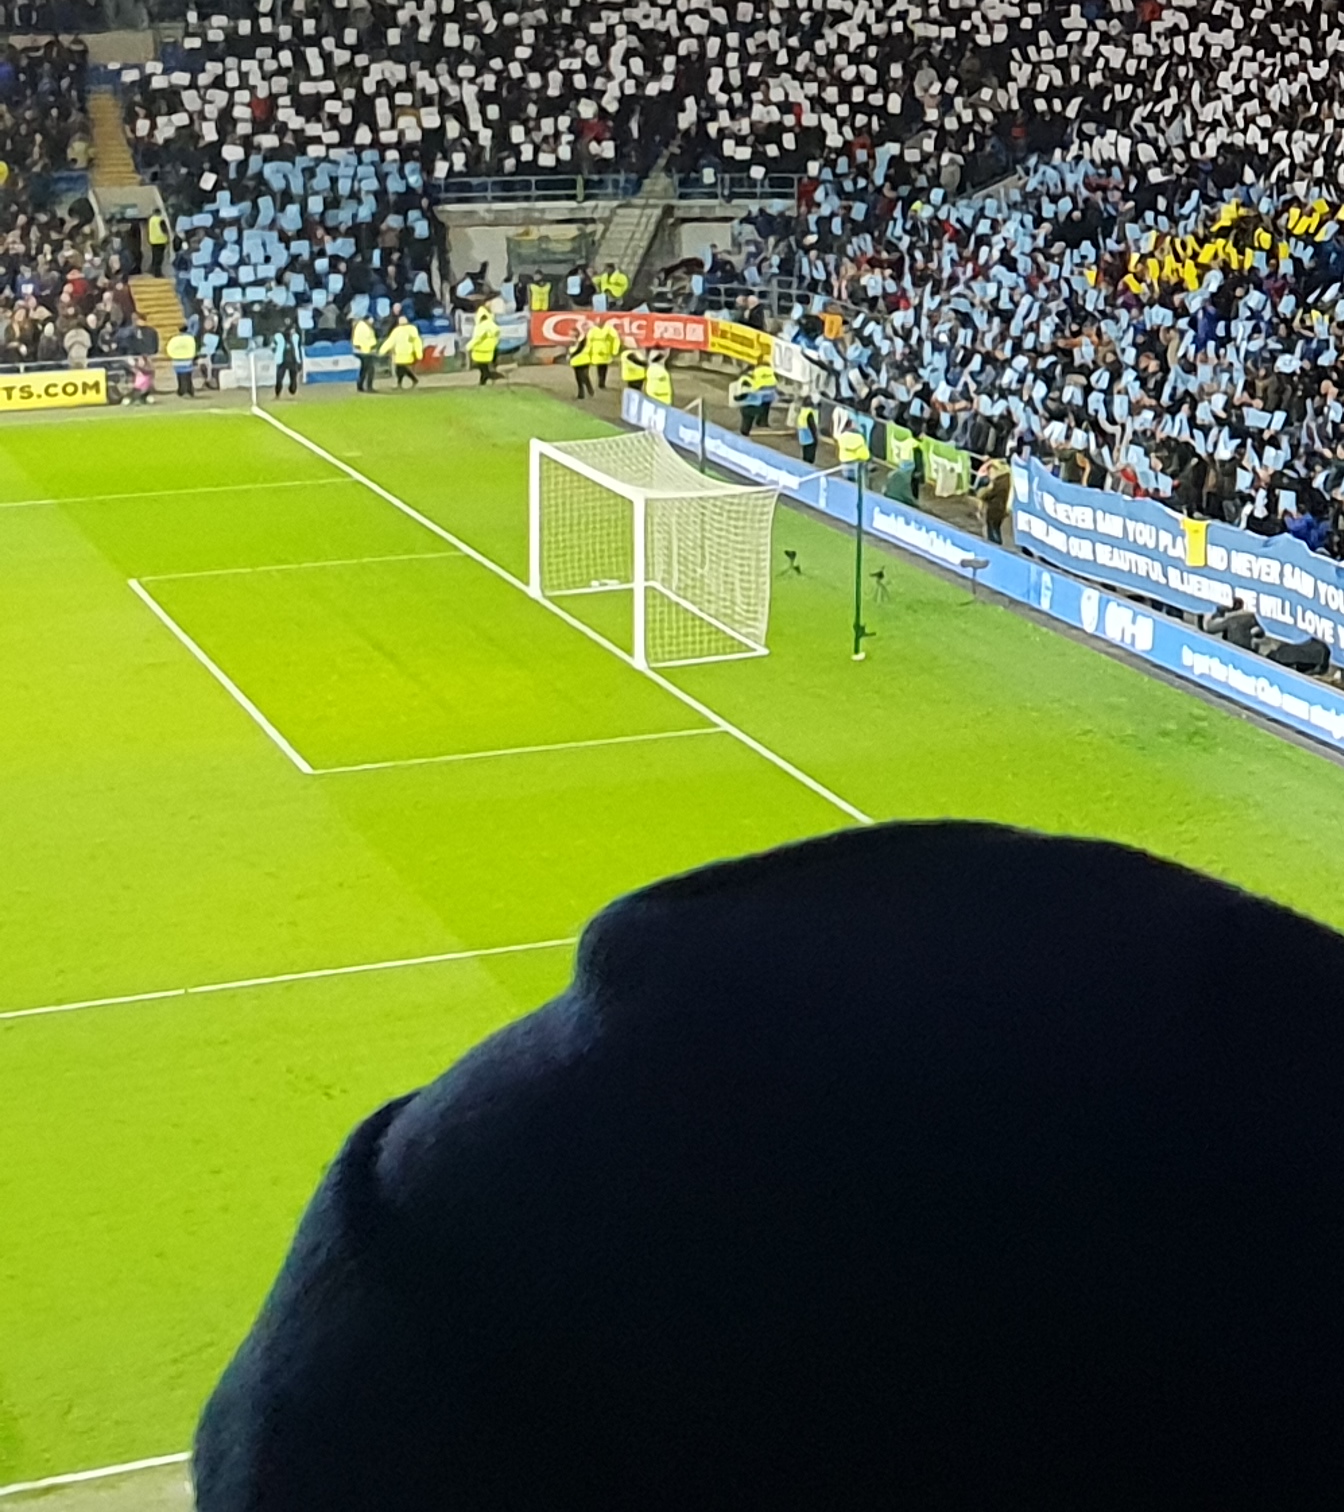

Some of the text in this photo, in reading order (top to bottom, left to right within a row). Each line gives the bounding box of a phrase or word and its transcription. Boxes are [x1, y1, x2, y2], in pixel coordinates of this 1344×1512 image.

[1095, 541, 1167, 585] BEAUTIFUL
[1260, 593, 1295, 625] WILL
[1297, 605, 1335, 644] LOVE
[1125, 518, 1156, 549] YOU
[1159, 529, 1187, 561] PLA
[1207, 544, 1228, 571] ND
[1231, 550, 1281, 584] NEVER
